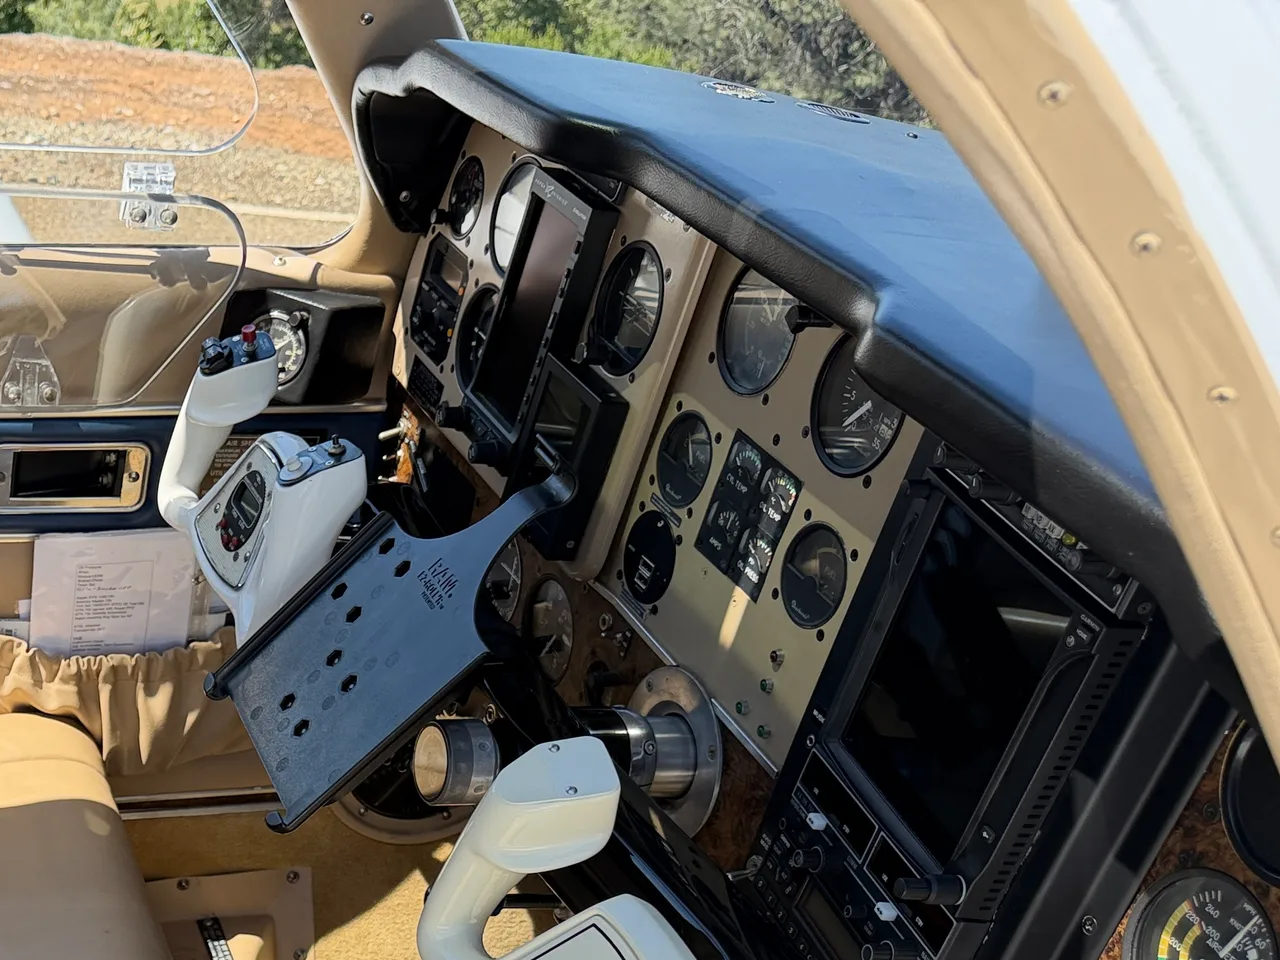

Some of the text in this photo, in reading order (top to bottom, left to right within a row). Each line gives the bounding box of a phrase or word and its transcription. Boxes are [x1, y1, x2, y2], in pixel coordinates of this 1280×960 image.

[849, 390, 856, 400] 5
[735, 480, 748, 493] TEMP
[768, 508, 781, 521] TEMP
[709, 537, 721, 550] AMPS
[745, 567, 758, 583] PRESS
[1081, 614, 1100, 631] GARMIN
[1205, 904, 1220, 918] 240
[1243, 903, 1256, 916] MPH
[1186, 911, 1200, 926] 220
[1205, 926, 1220, 941] 200
[1168, 937, 1184, 951] 200
[1255, 938, 1266, 949] 60
